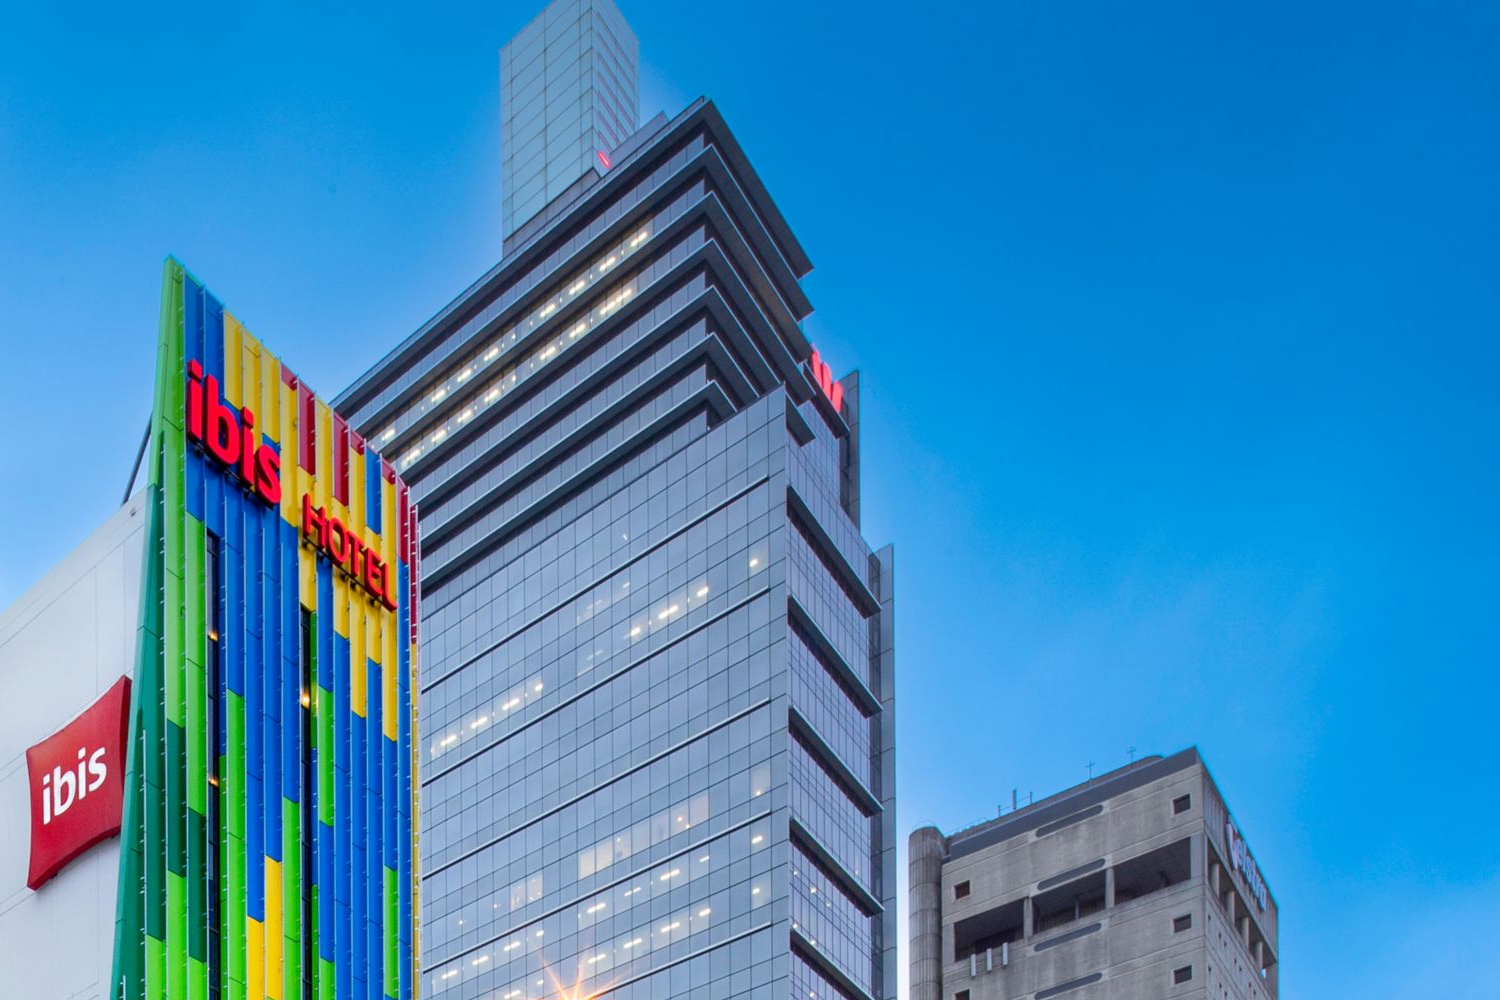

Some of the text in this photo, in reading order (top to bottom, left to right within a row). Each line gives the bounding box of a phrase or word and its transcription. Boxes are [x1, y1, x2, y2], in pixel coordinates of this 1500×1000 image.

[186, 359, 282, 508] ibis
[301, 493, 398, 613] HOTEL
[41, 745, 107, 825] ibis
